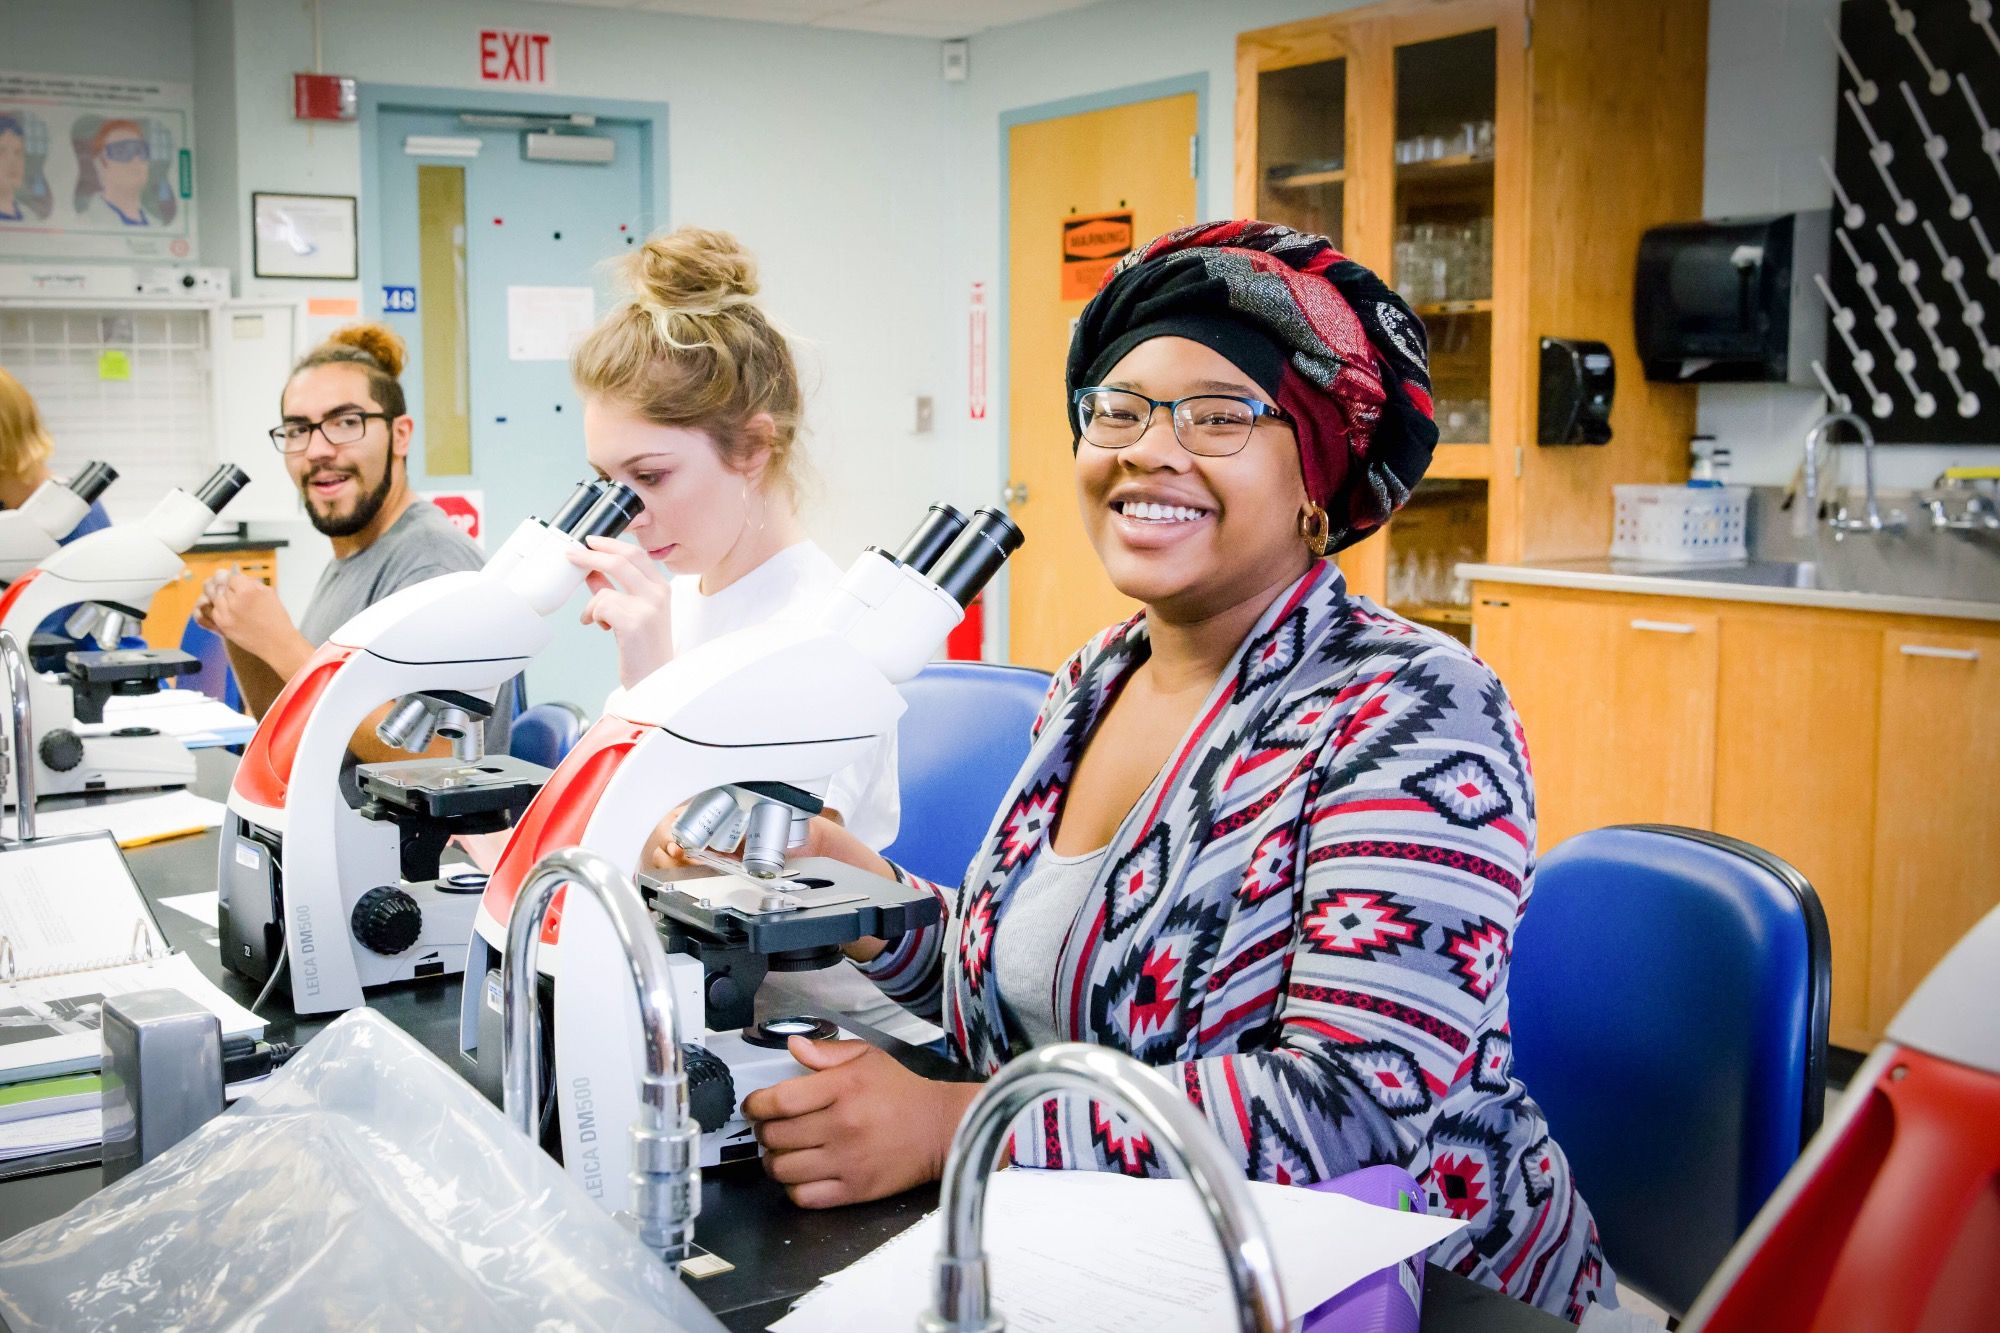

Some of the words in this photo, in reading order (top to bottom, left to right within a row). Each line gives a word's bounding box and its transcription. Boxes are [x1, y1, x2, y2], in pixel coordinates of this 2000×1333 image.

[480, 30, 550, 82] EXIT
[296, 904, 315, 955] DM500
[303, 957, 320, 997] LEICA
[573, 1076, 597, 1144] DM500
[582, 1147, 604, 1199] LEICA
